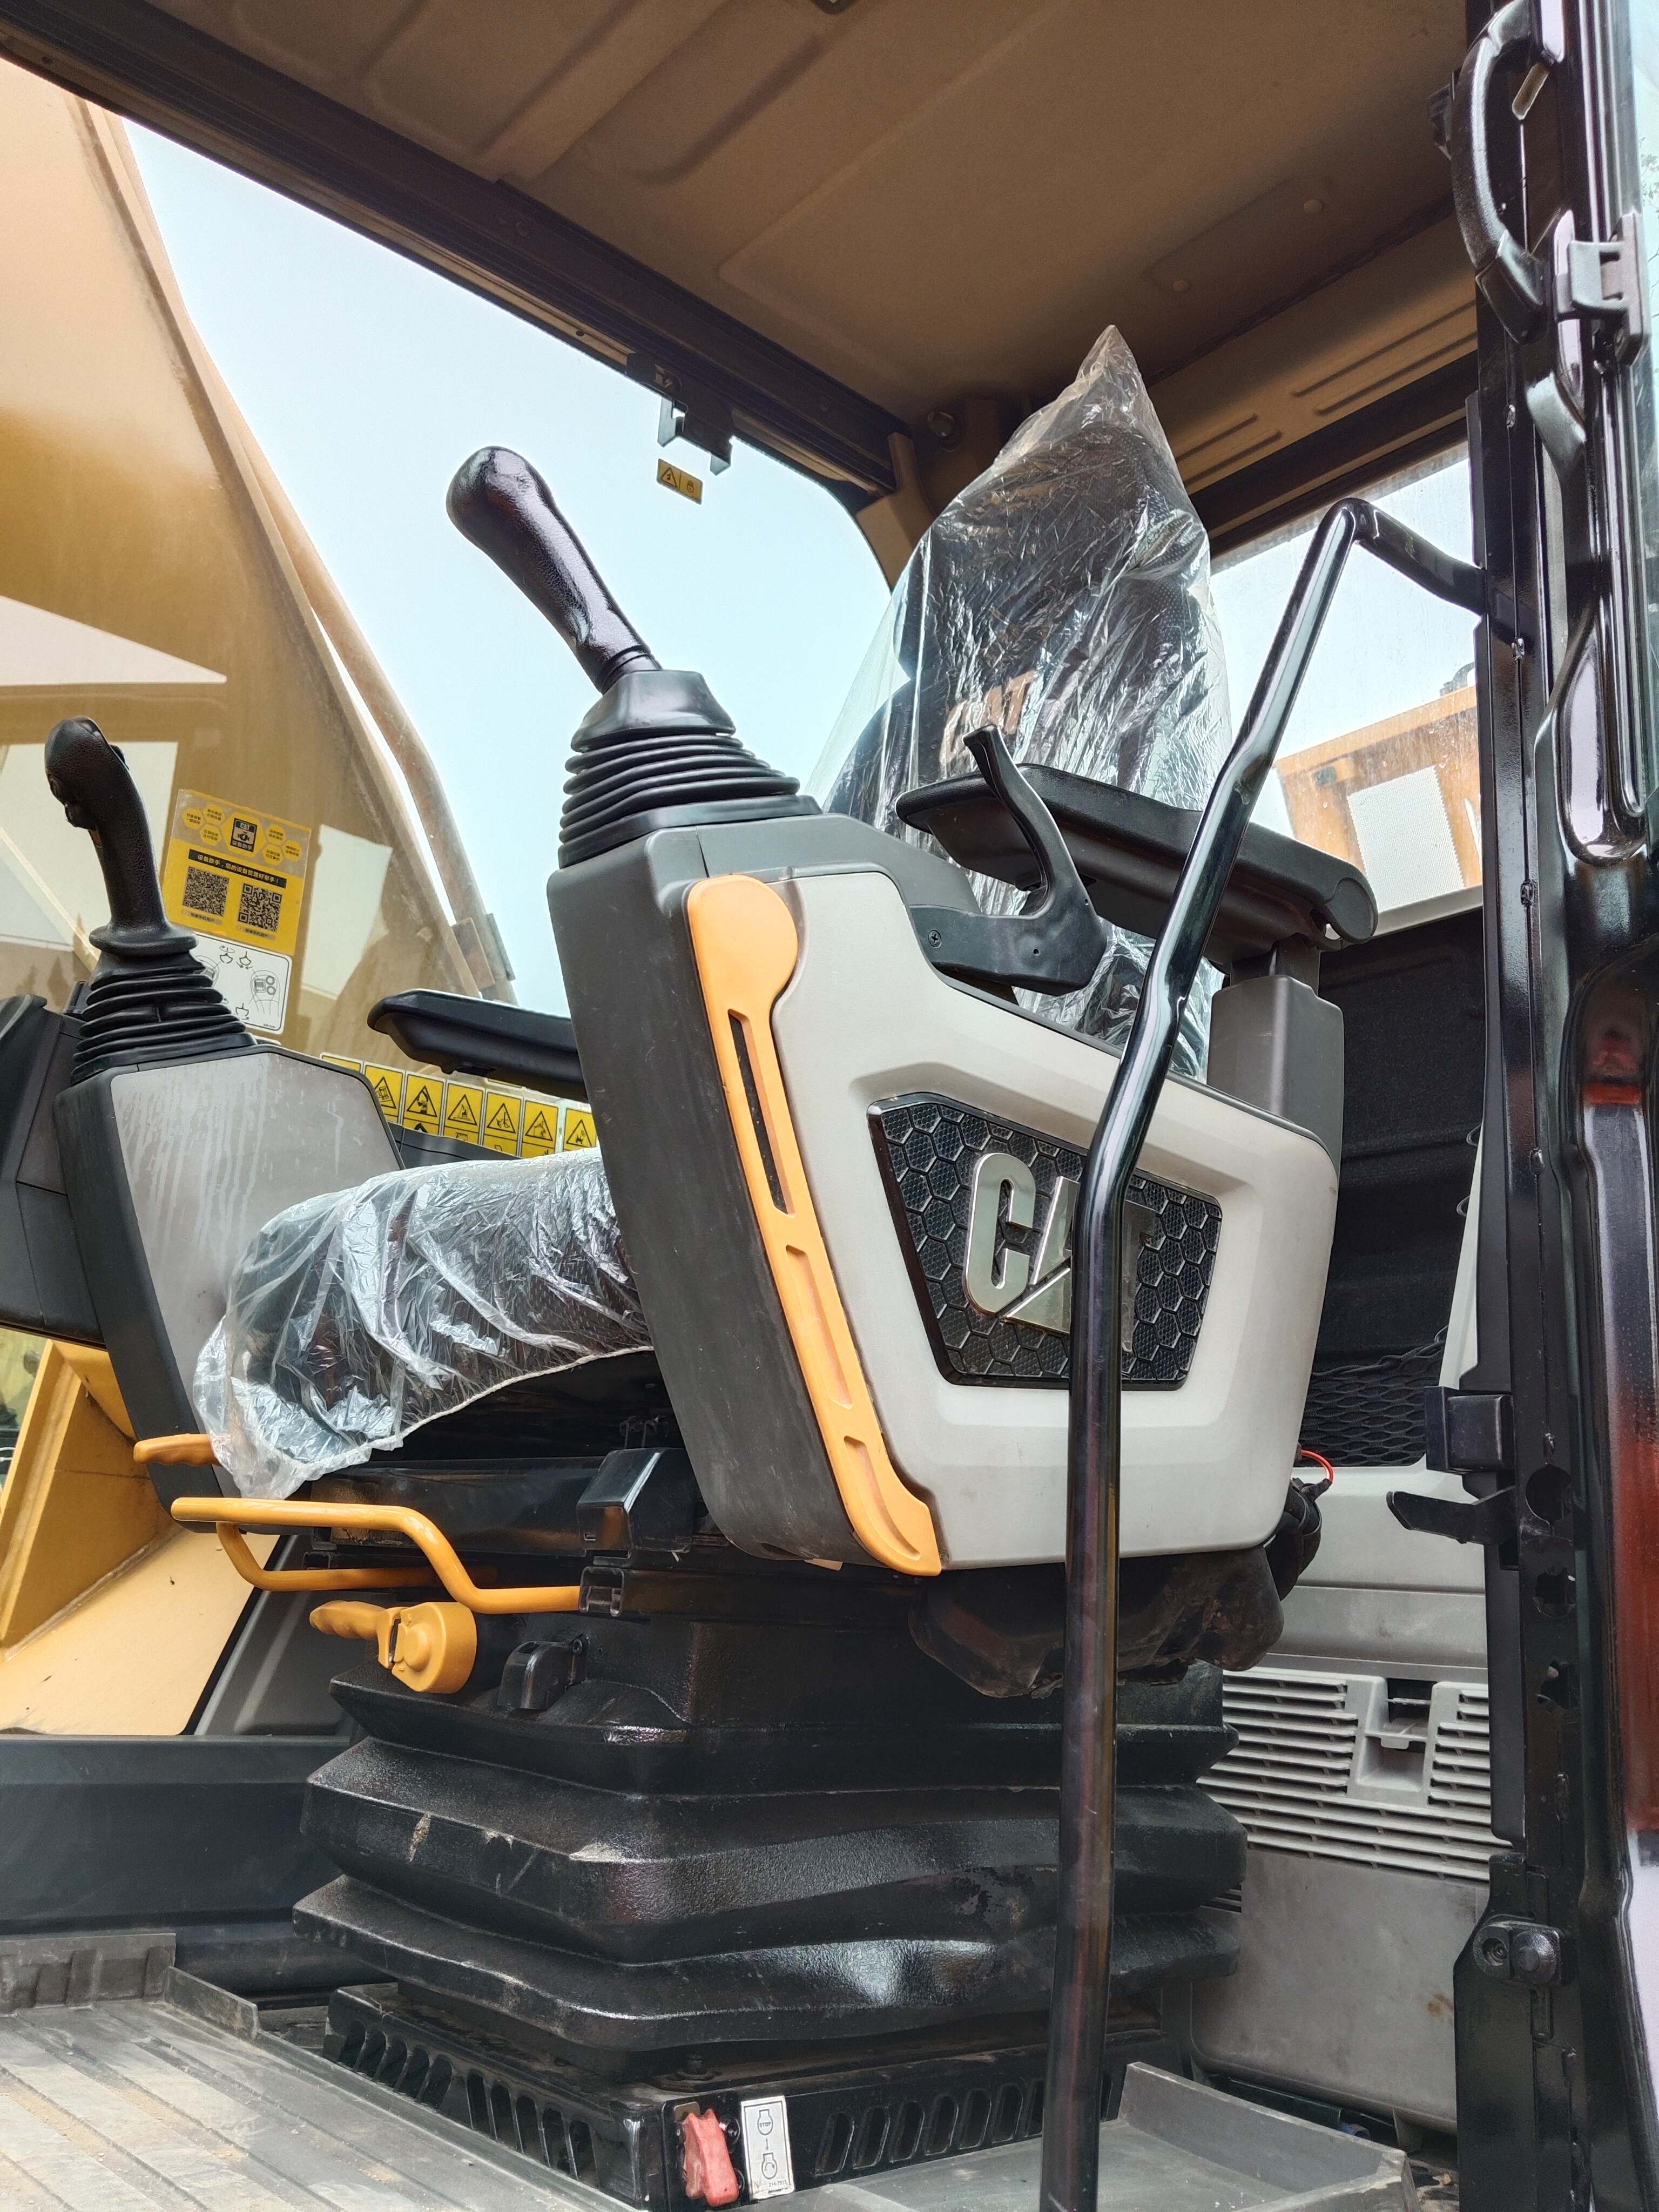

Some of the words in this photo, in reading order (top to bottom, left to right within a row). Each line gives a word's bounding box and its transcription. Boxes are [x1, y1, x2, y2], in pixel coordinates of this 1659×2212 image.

[240, 822, 252, 831] CAT
[232, 840, 253, 851] 设备助手
